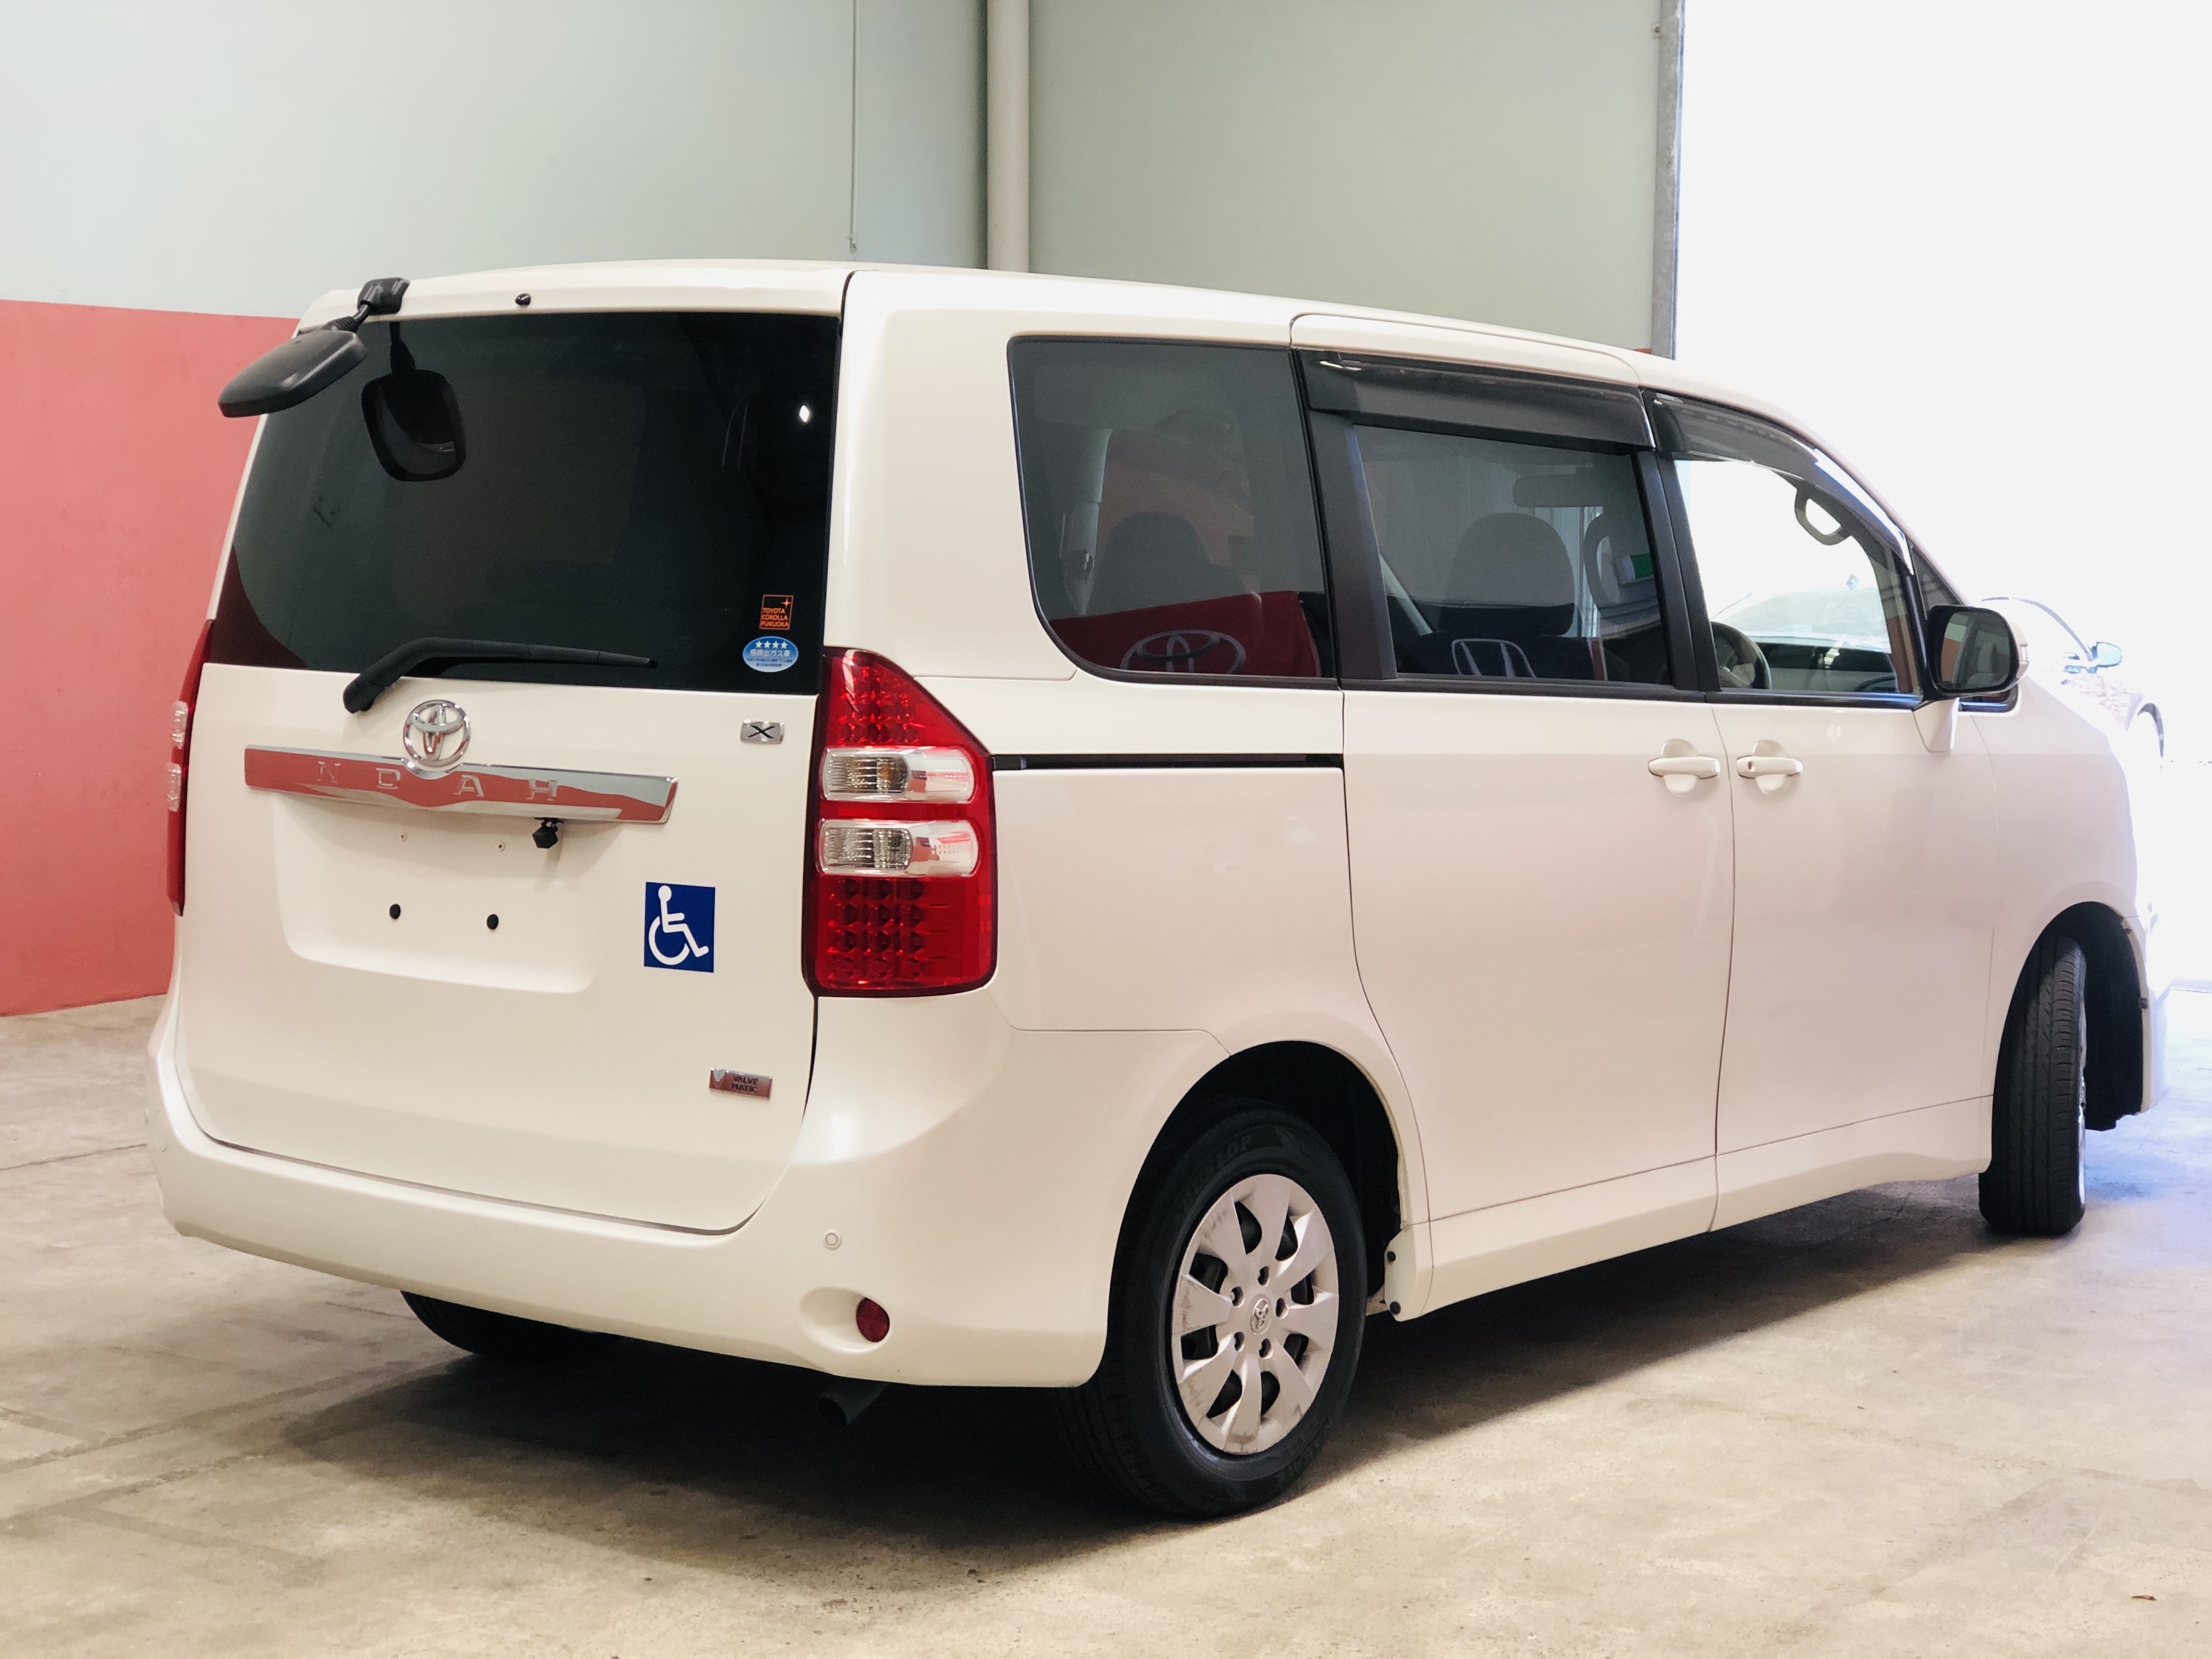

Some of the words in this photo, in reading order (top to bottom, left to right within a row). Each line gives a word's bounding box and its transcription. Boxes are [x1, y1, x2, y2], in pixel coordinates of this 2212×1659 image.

[747, 725, 776, 739] X
[317, 761, 558, 802] NOAH
[733, 1076, 759, 1086] VALVE
[731, 1083, 758, 1093] MATIC
